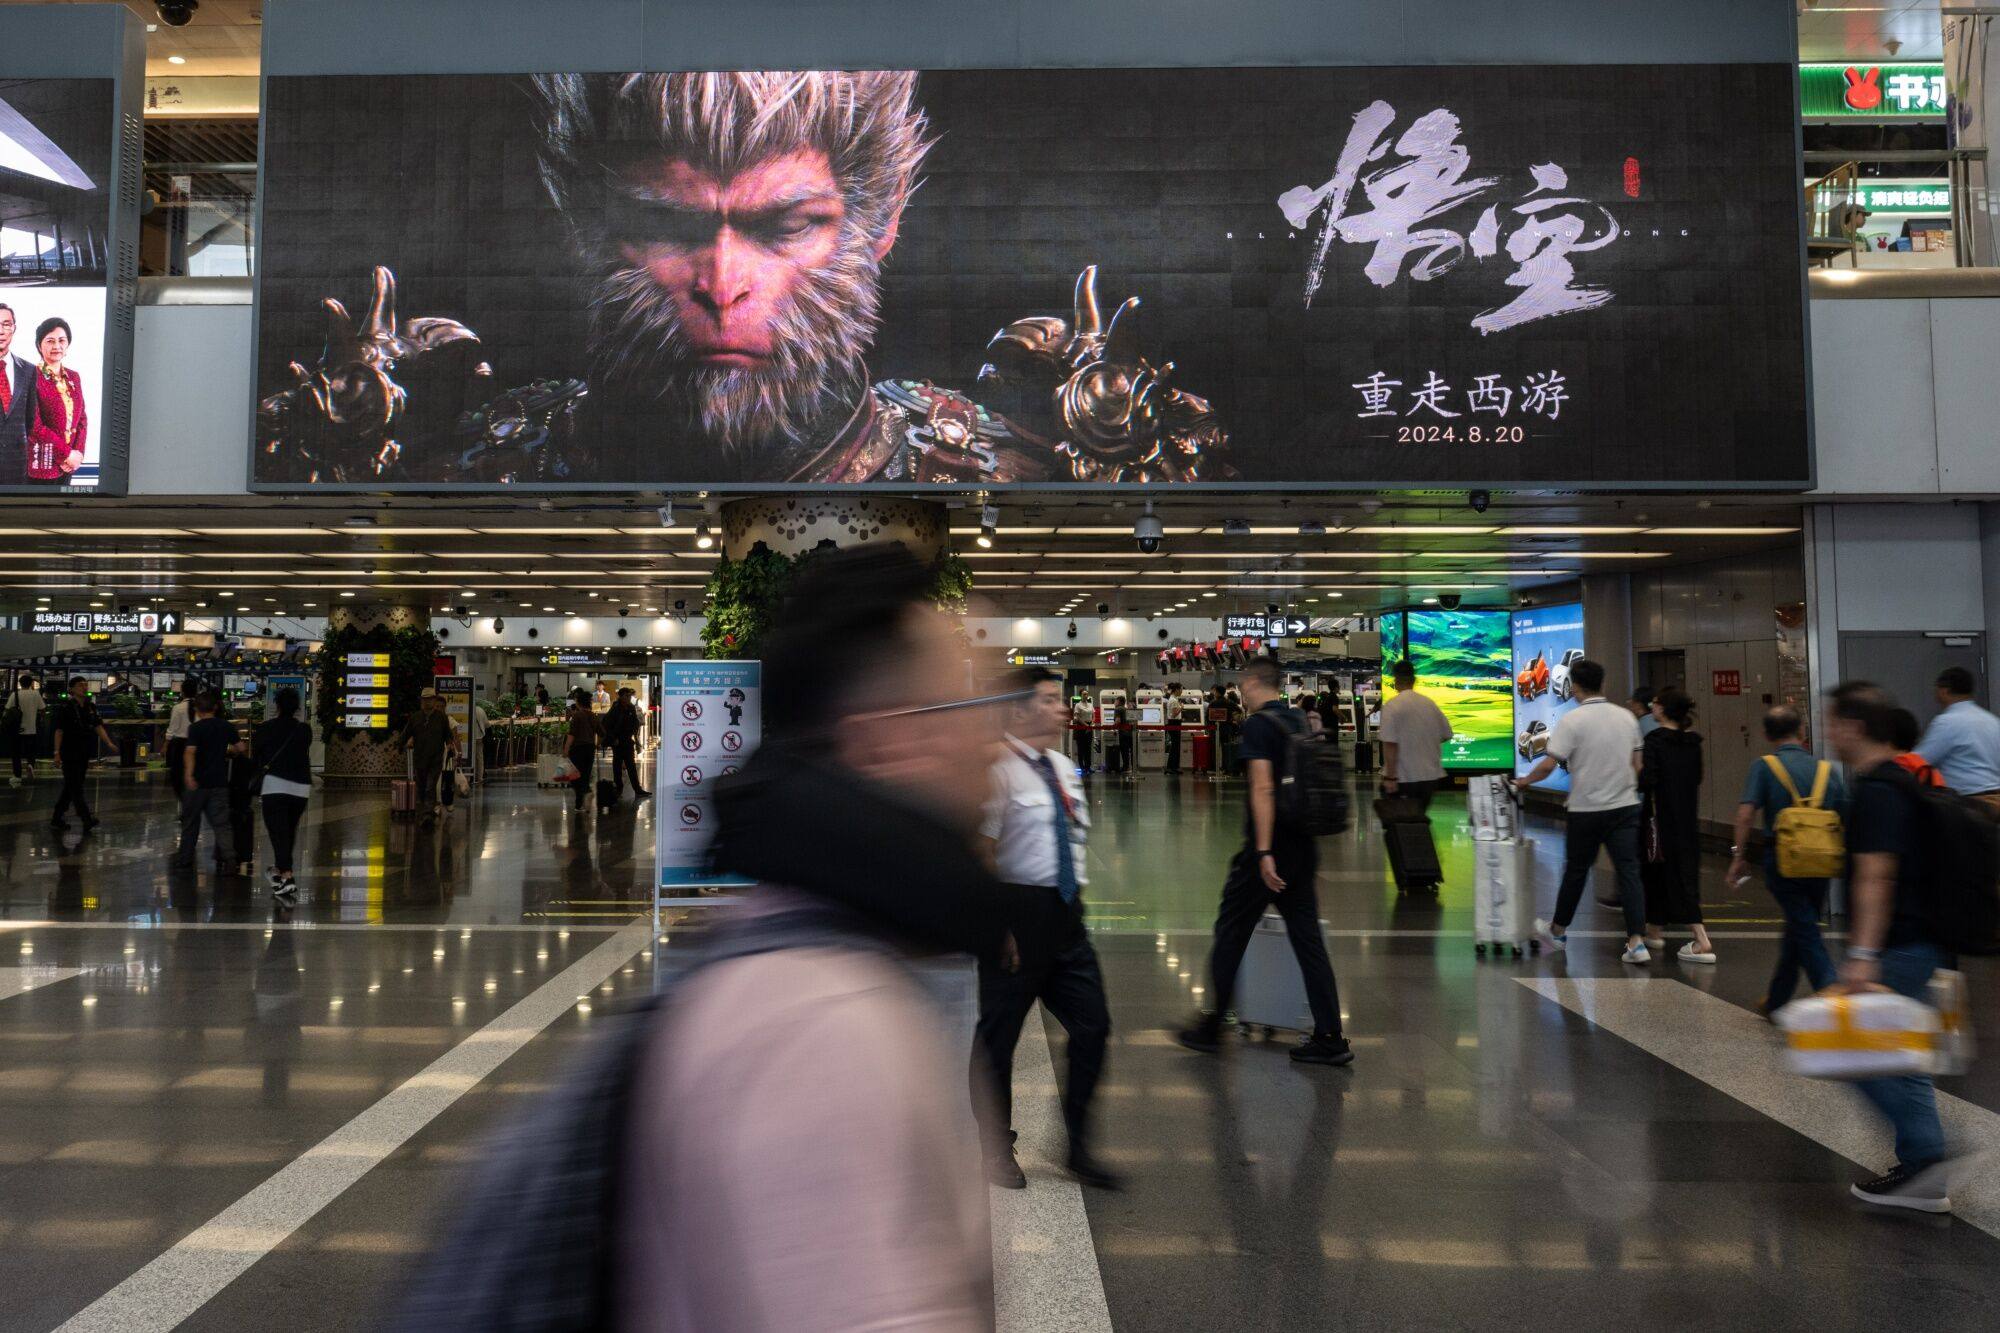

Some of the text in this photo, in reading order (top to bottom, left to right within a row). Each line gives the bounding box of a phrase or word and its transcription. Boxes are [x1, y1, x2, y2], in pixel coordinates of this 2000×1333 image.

[1277, 100, 1620, 336] 悟空
[1226, 231, 1356, 239] BLACK
[1352, 369, 1570, 420] 重走西游
[1398, 426, 1524, 443] 2024.8.20
[35, 613, 72, 624] 机场办证
[1227, 617, 1266, 628] 行李打包
[33, 624, 72, 633] Airport Pass
[95, 624, 139, 632] Police Station
